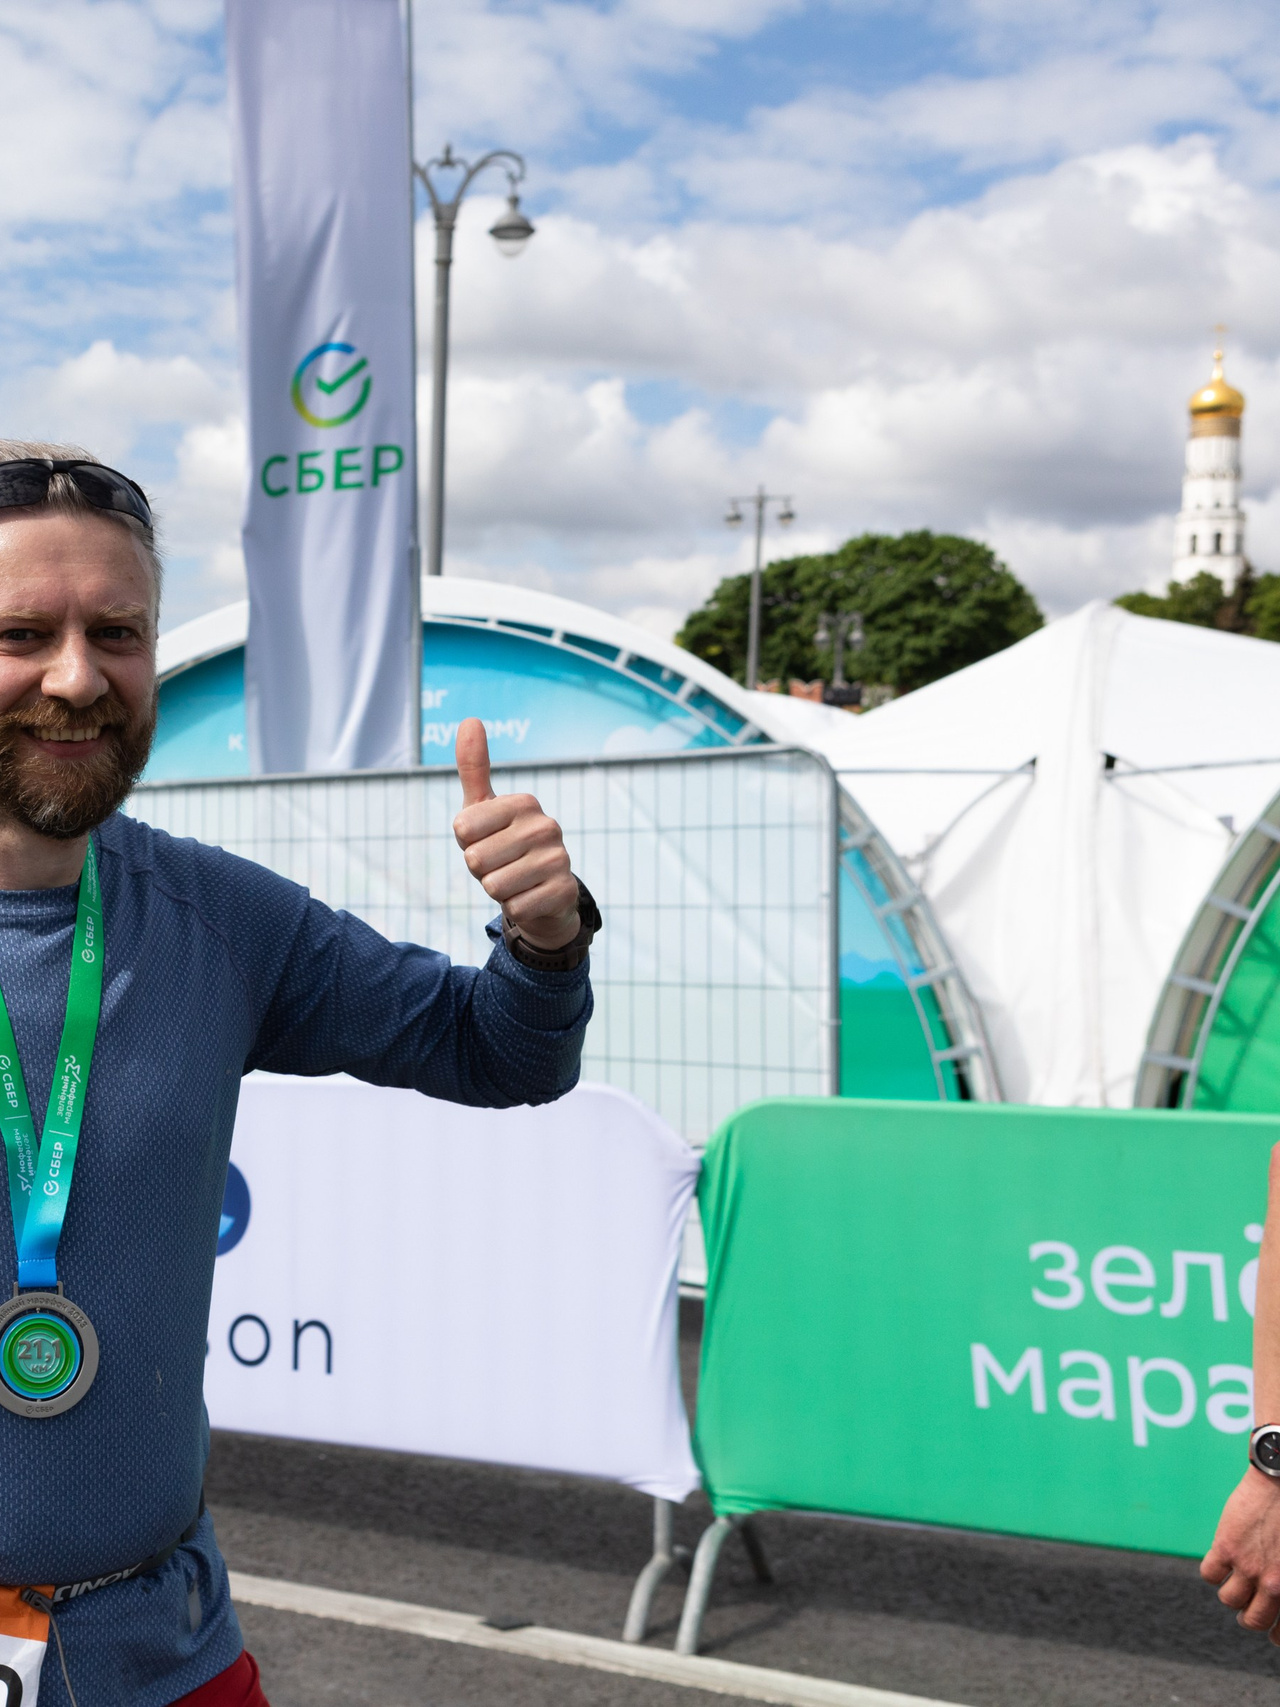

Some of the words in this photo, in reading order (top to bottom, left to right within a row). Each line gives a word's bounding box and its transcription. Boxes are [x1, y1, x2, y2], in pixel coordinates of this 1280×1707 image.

[261, 444, 404, 498] СБЕР
[85, 916, 95, 947] СБЕР
[2, 1073, 19, 1108] СБЕР
[57, 1075, 70, 1117] зелёный
[64, 1081, 78, 1124] марафон
[13, 1128, 26, 1173] марафон
[49, 1141, 64, 1178] СБЕР
[67, 1307, 88, 1329] 2023
[17, 1338, 62, 1362] 21,1
[205, 1314, 332, 1375] on
[970, 1342, 1255, 1447] мара
